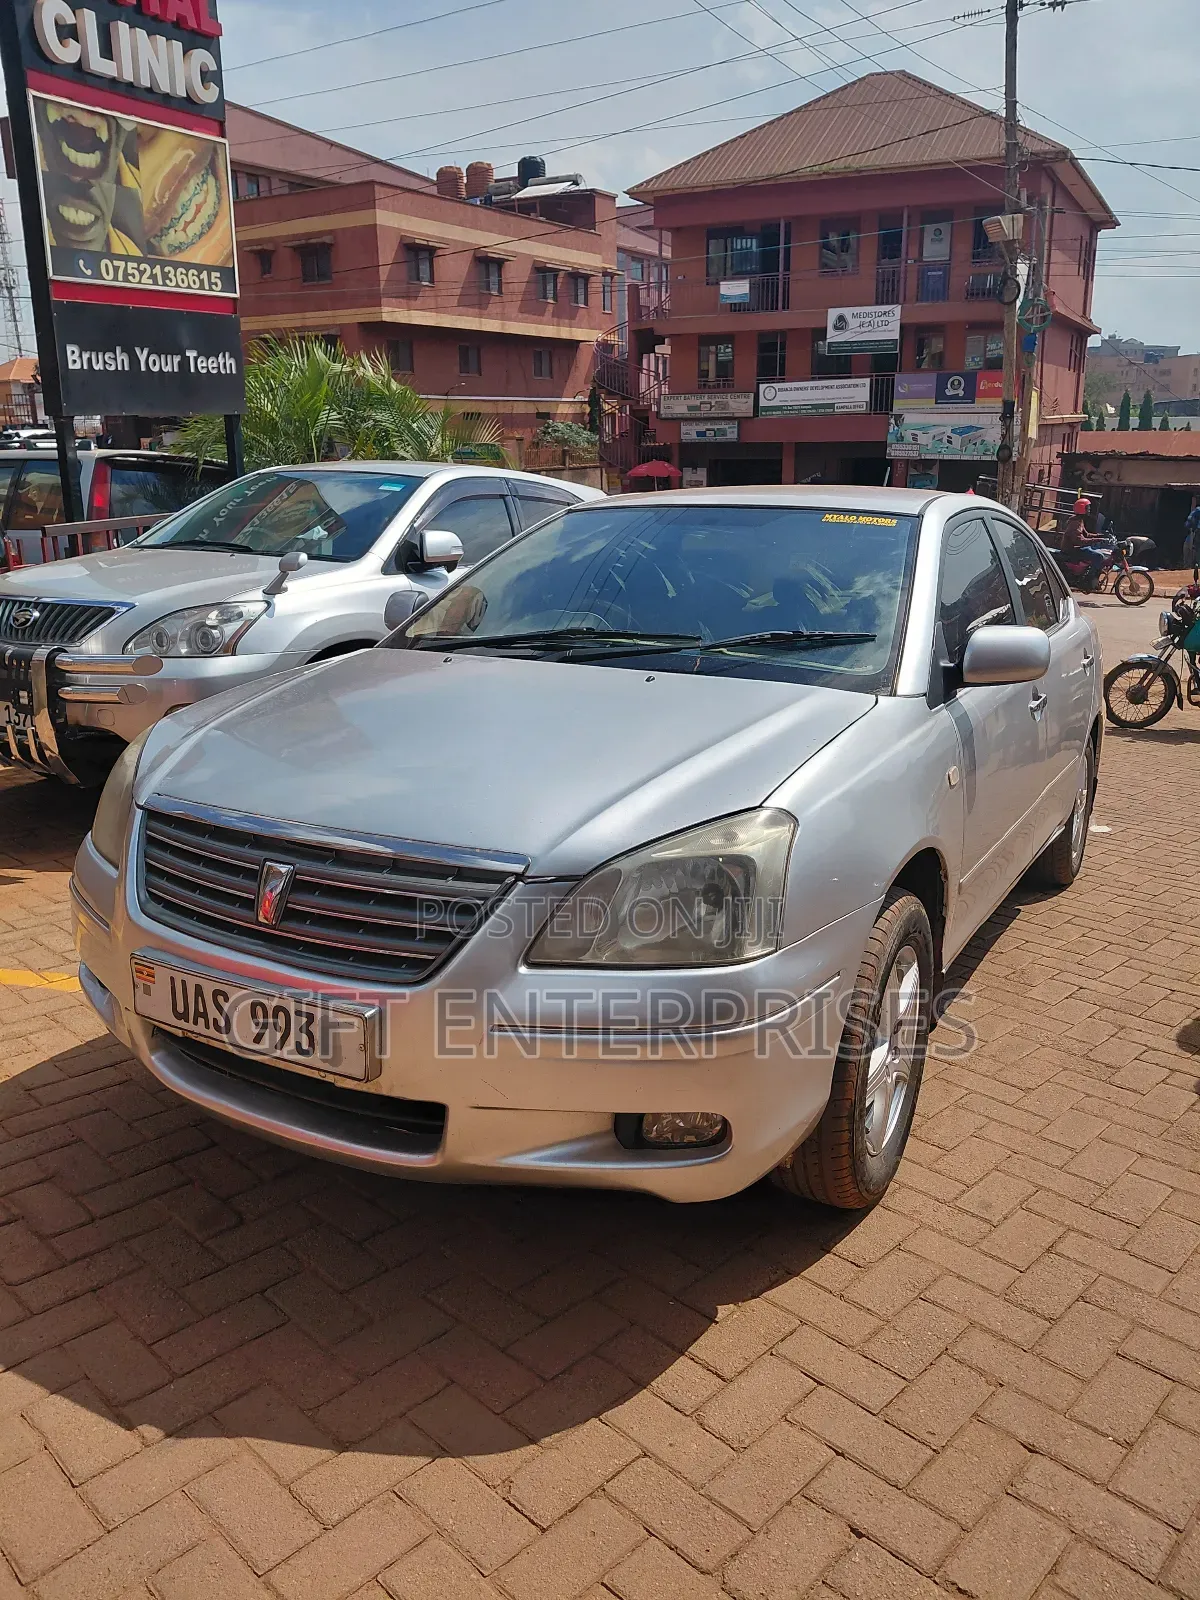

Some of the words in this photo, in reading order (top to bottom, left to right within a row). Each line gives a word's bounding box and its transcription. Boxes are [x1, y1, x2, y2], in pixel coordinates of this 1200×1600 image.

[34, 0, 220, 104] CLINIC
[100, 258, 222, 292] 0752136615
[852, 310, 896, 319] MEDISTORES
[66, 344, 130, 373] Brush
[134, 346, 181, 374] Your
[185, 349, 237, 375] Teeth
[858, 516, 897, 525] MOTORS
[170, 975, 231, 1036] UAS
[250, 999, 342, 1067] 993
